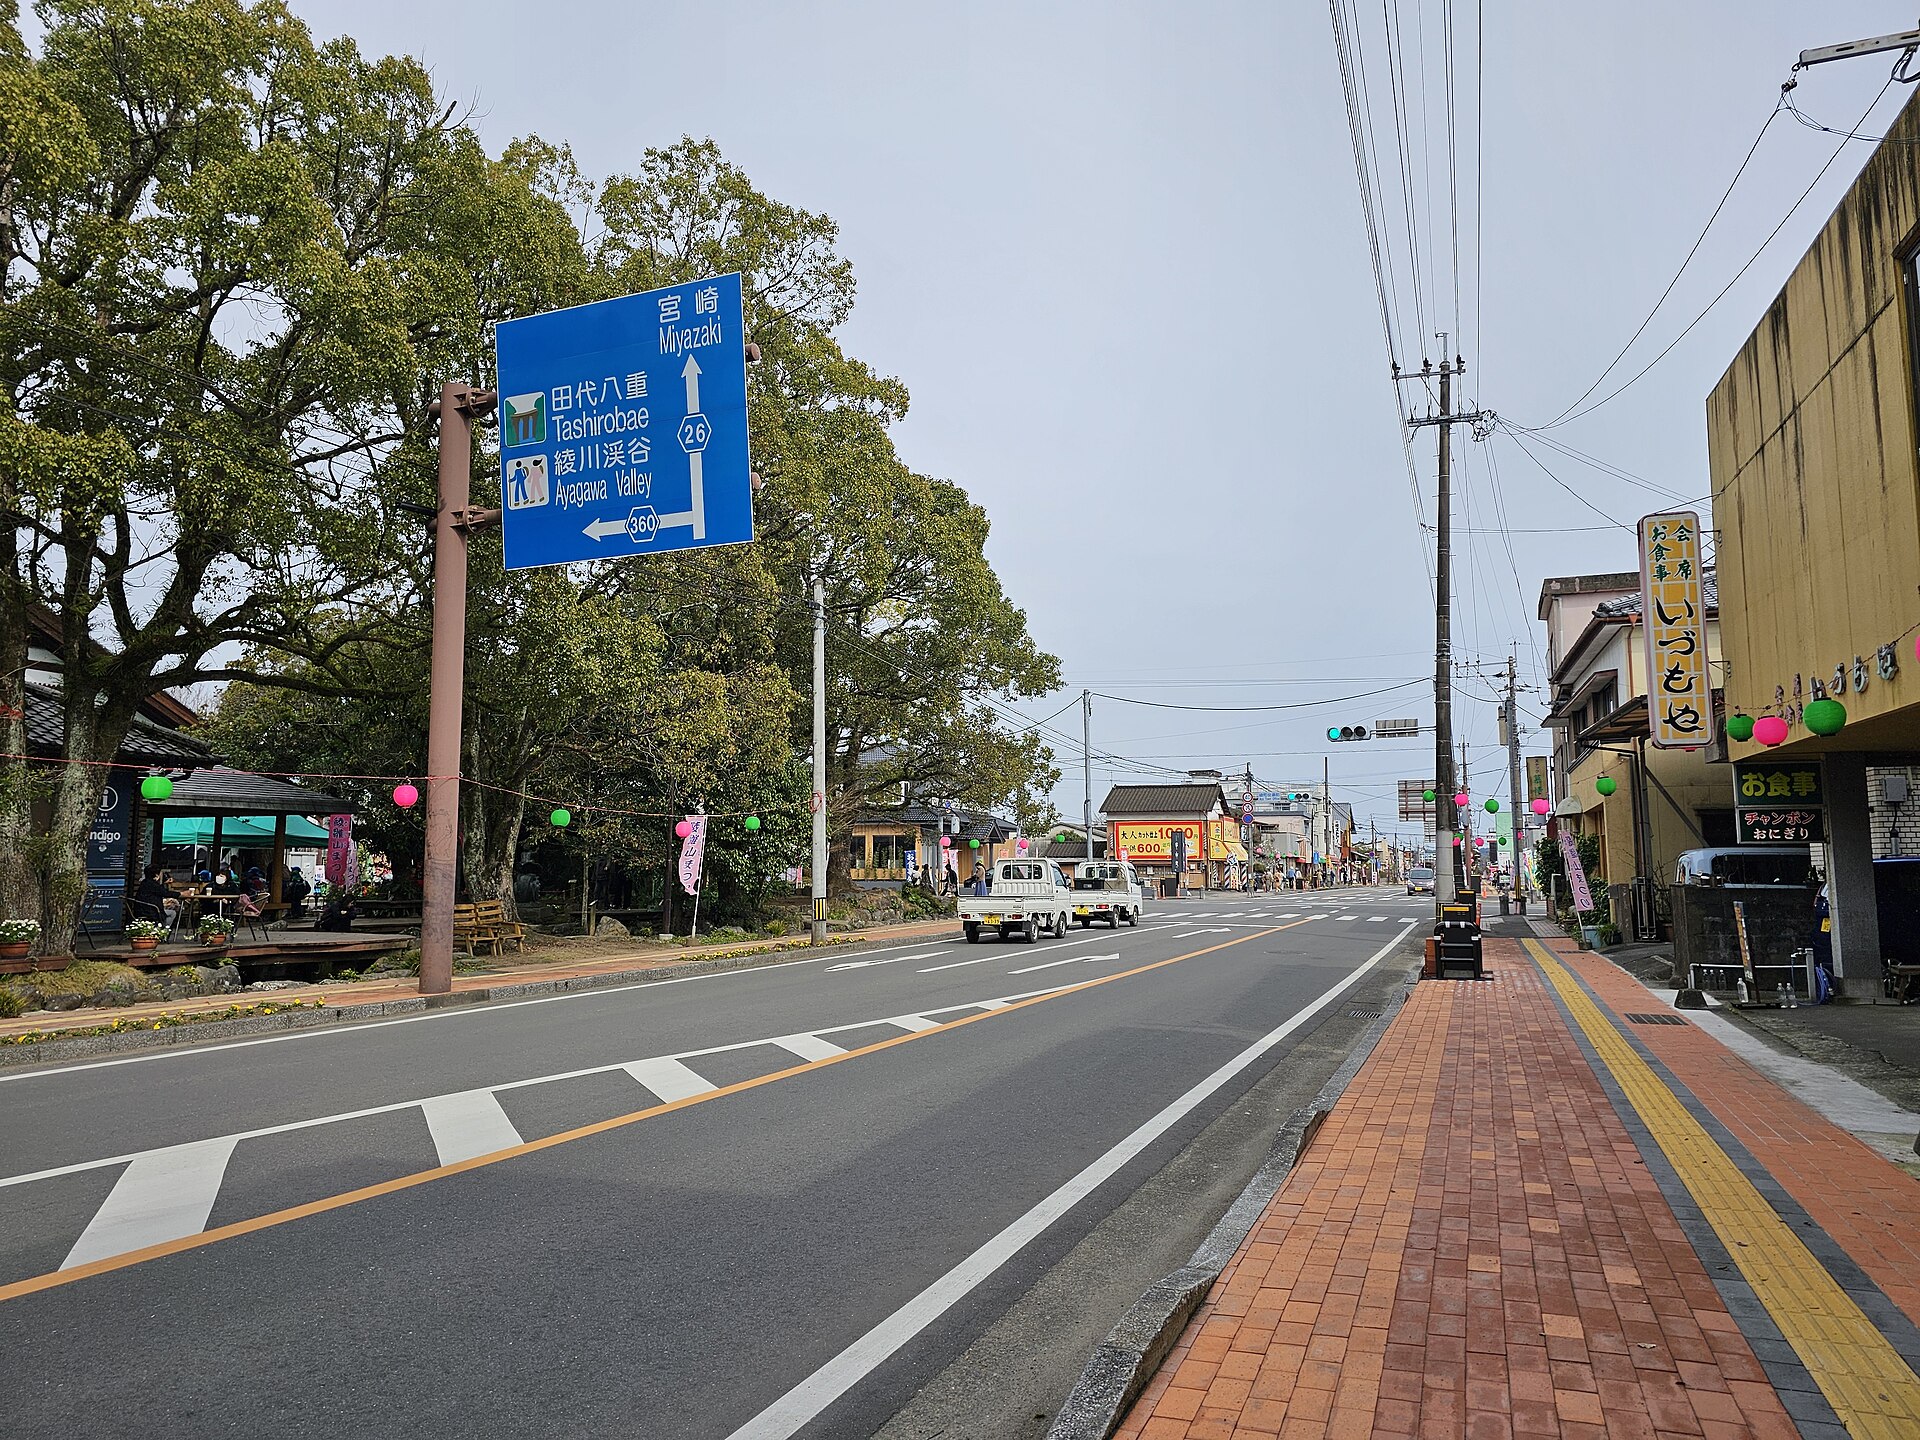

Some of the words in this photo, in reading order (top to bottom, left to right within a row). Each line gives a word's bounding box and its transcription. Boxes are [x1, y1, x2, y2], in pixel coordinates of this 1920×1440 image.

[658, 286, 720, 323] 宮崎
[659, 316, 722, 358] Miyazaki
[551, 370, 648, 412] 田代八重
[551, 407, 650, 443] Tashirobae
[684, 424, 706, 444] 26
[553, 436, 652, 477] 綾川渓谷
[555, 478, 608, 511] Ayagawa
[615, 467, 652, 499] Valley
[629, 514, 656, 534] 360
[1647, 525, 1673, 583] お食事
[1671, 524, 1694, 581] 会席
[1654, 596, 1705, 733] いづもや
[1741, 770, 1817, 797] お食事
[89, 829, 121, 843] ndigo
[1121, 831, 1137, 840] 大人
[1744, 811, 1816, 826] チャンポン
[1753, 827, 1809, 840] おにぎり
